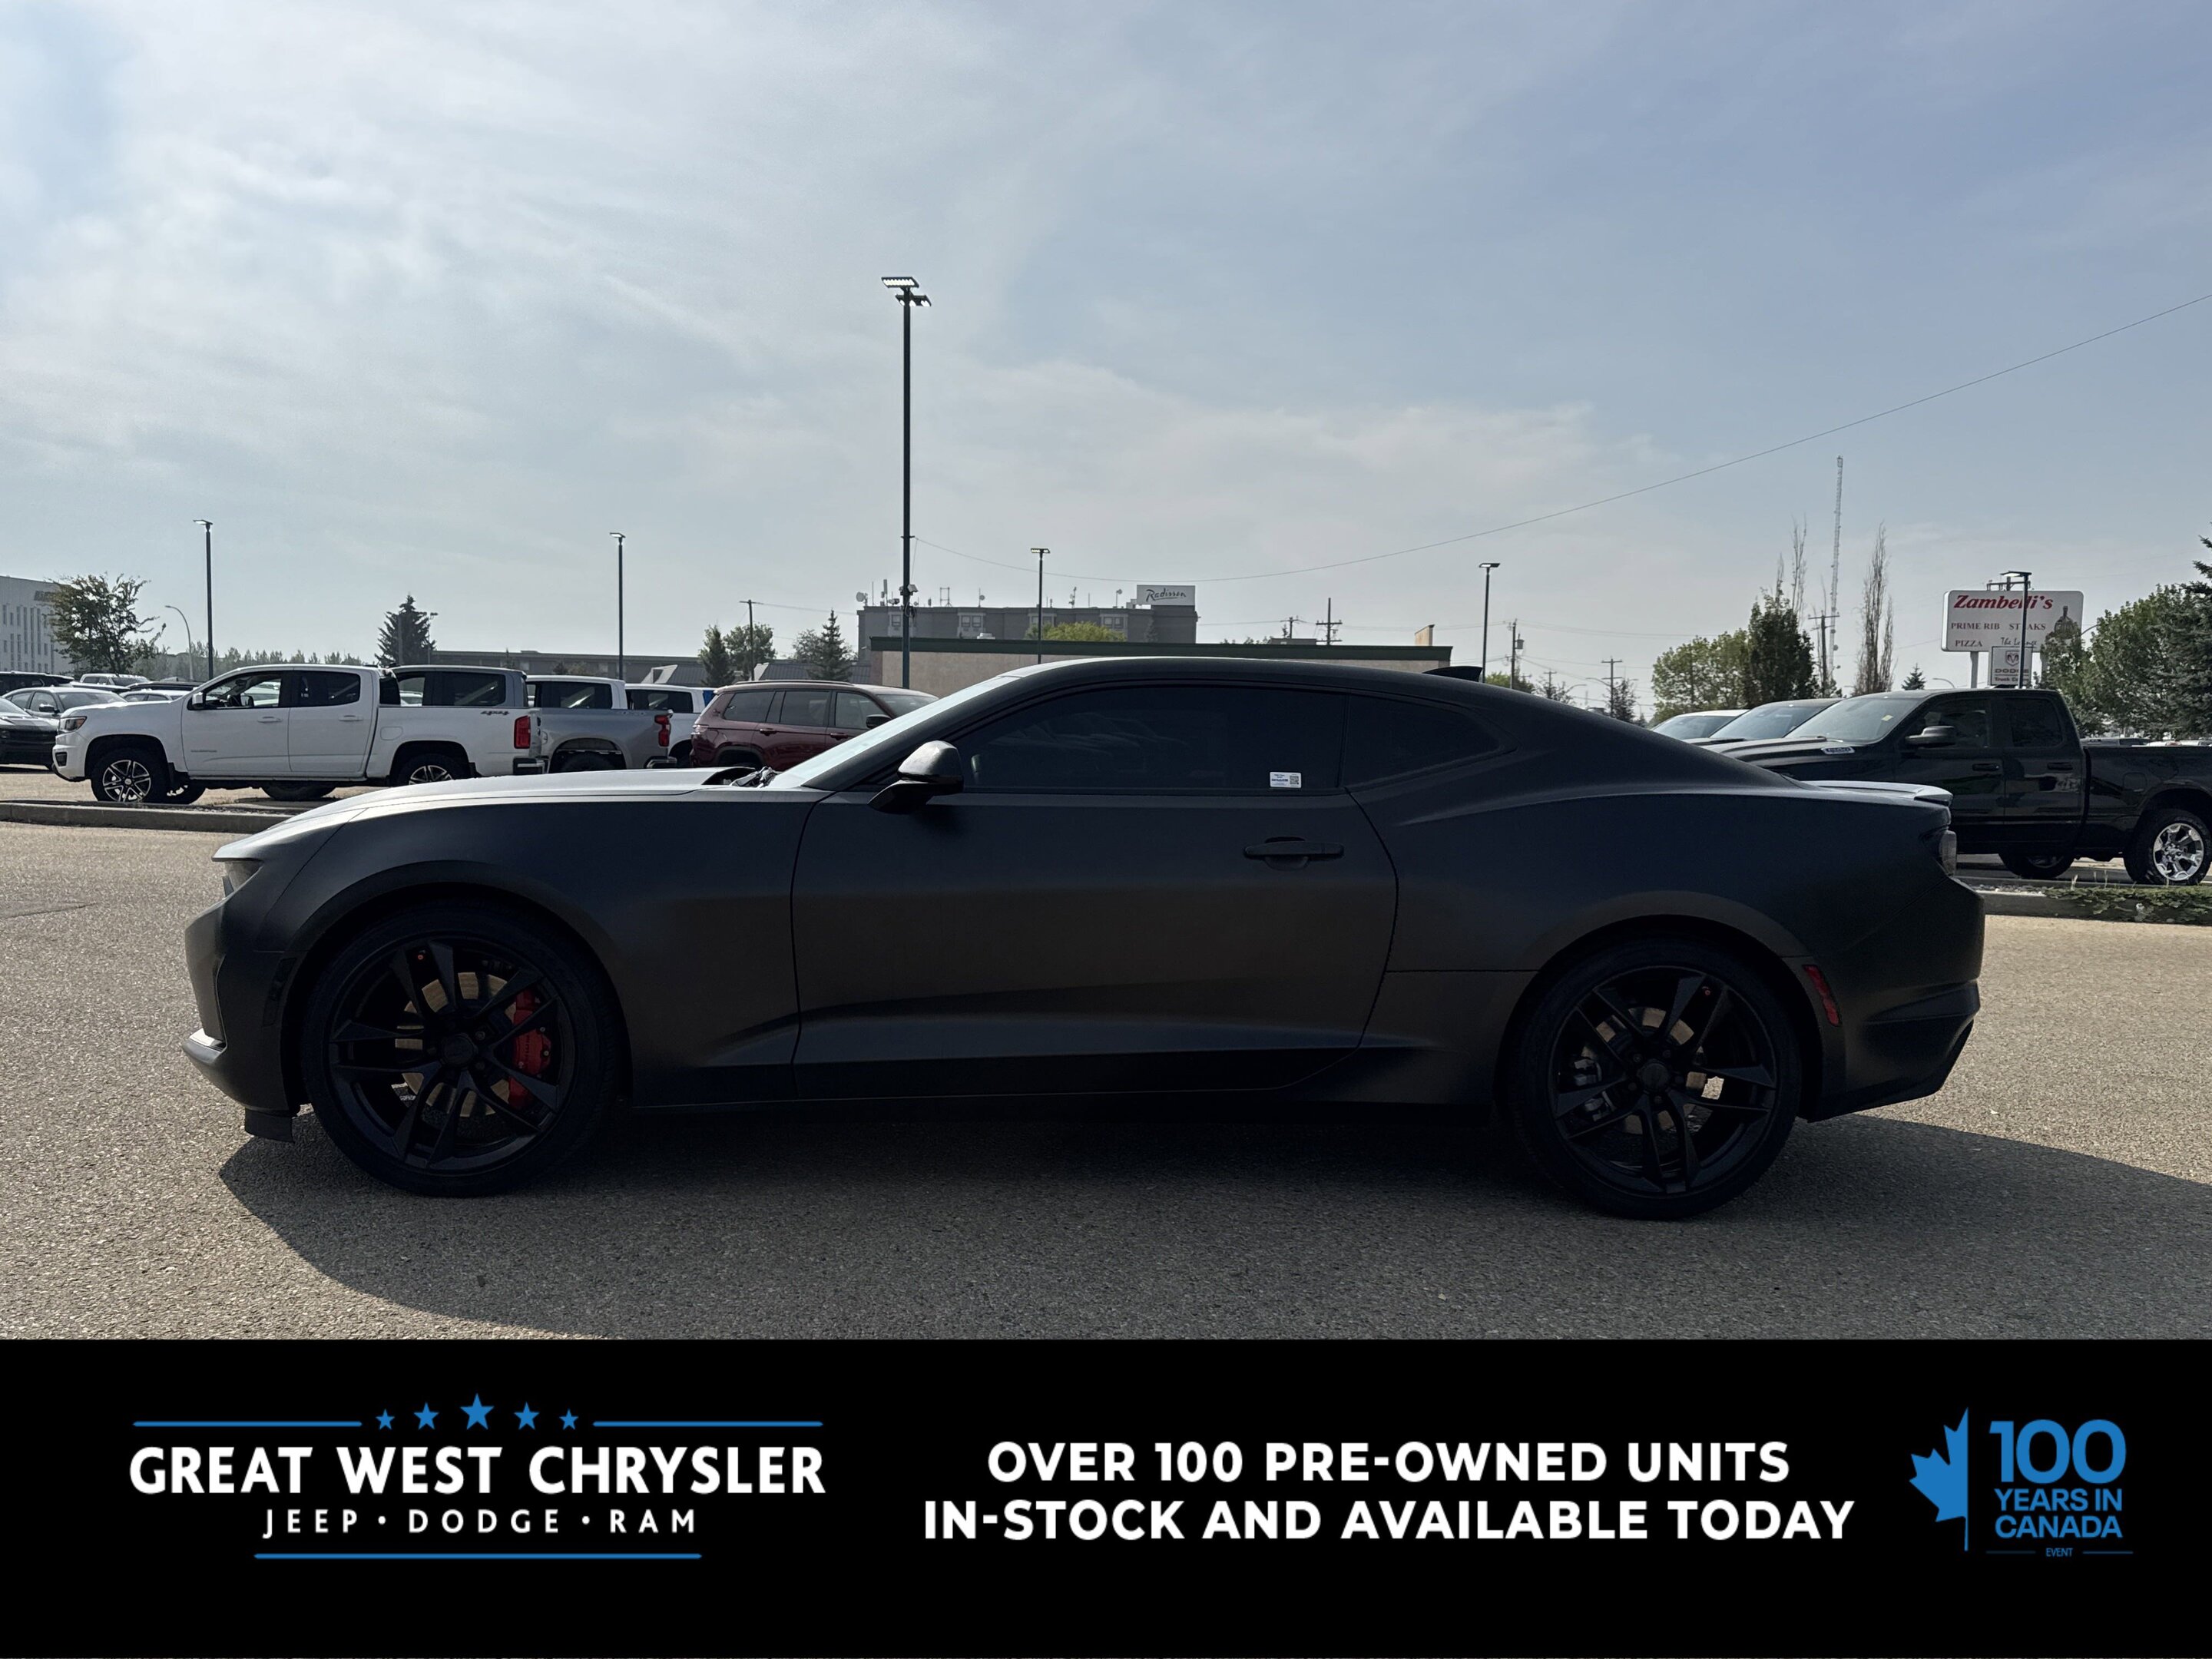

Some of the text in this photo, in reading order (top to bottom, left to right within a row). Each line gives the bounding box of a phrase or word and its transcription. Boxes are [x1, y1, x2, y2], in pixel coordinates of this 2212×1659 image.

[1145, 587, 1187, 603] Radisson
[1951, 622, 1981, 631] PRIME
[1955, 639, 1983, 647] PIZZA
